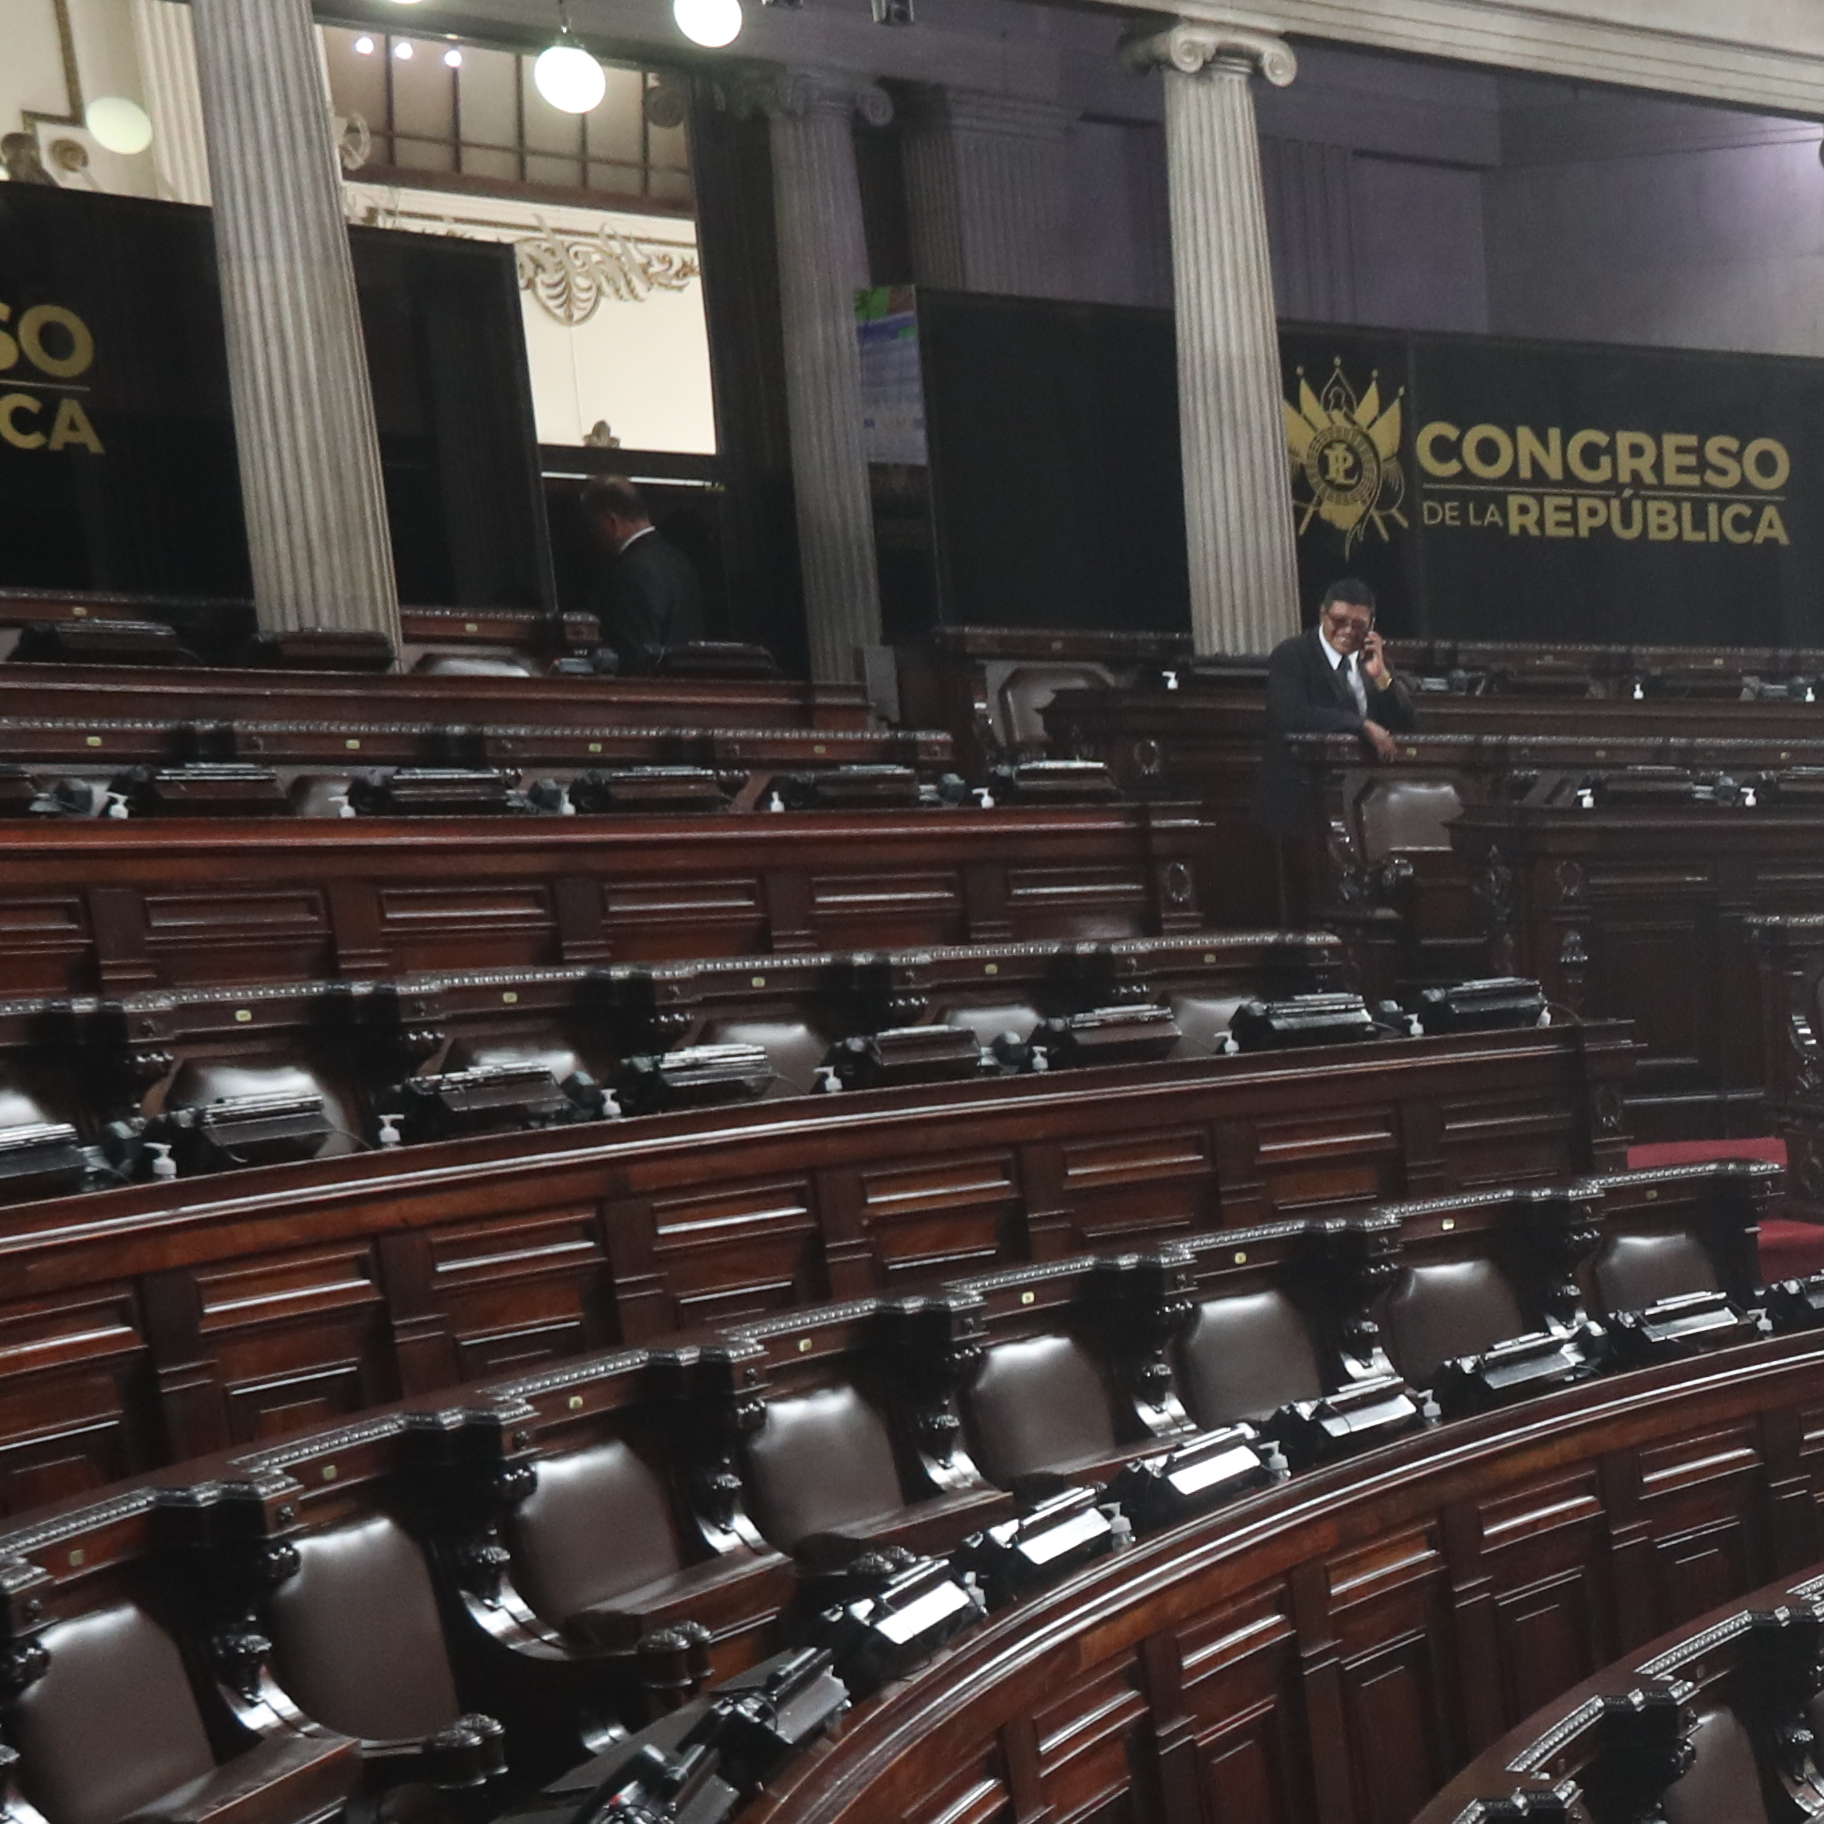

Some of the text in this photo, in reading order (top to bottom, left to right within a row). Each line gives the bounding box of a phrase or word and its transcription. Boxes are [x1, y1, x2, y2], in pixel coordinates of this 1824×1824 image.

[0, 393, 106, 454] CA
[1415, 420, 1792, 491] CONGRESO
[1423, 488, 1790, 546] DE LA REPÚBLICA
